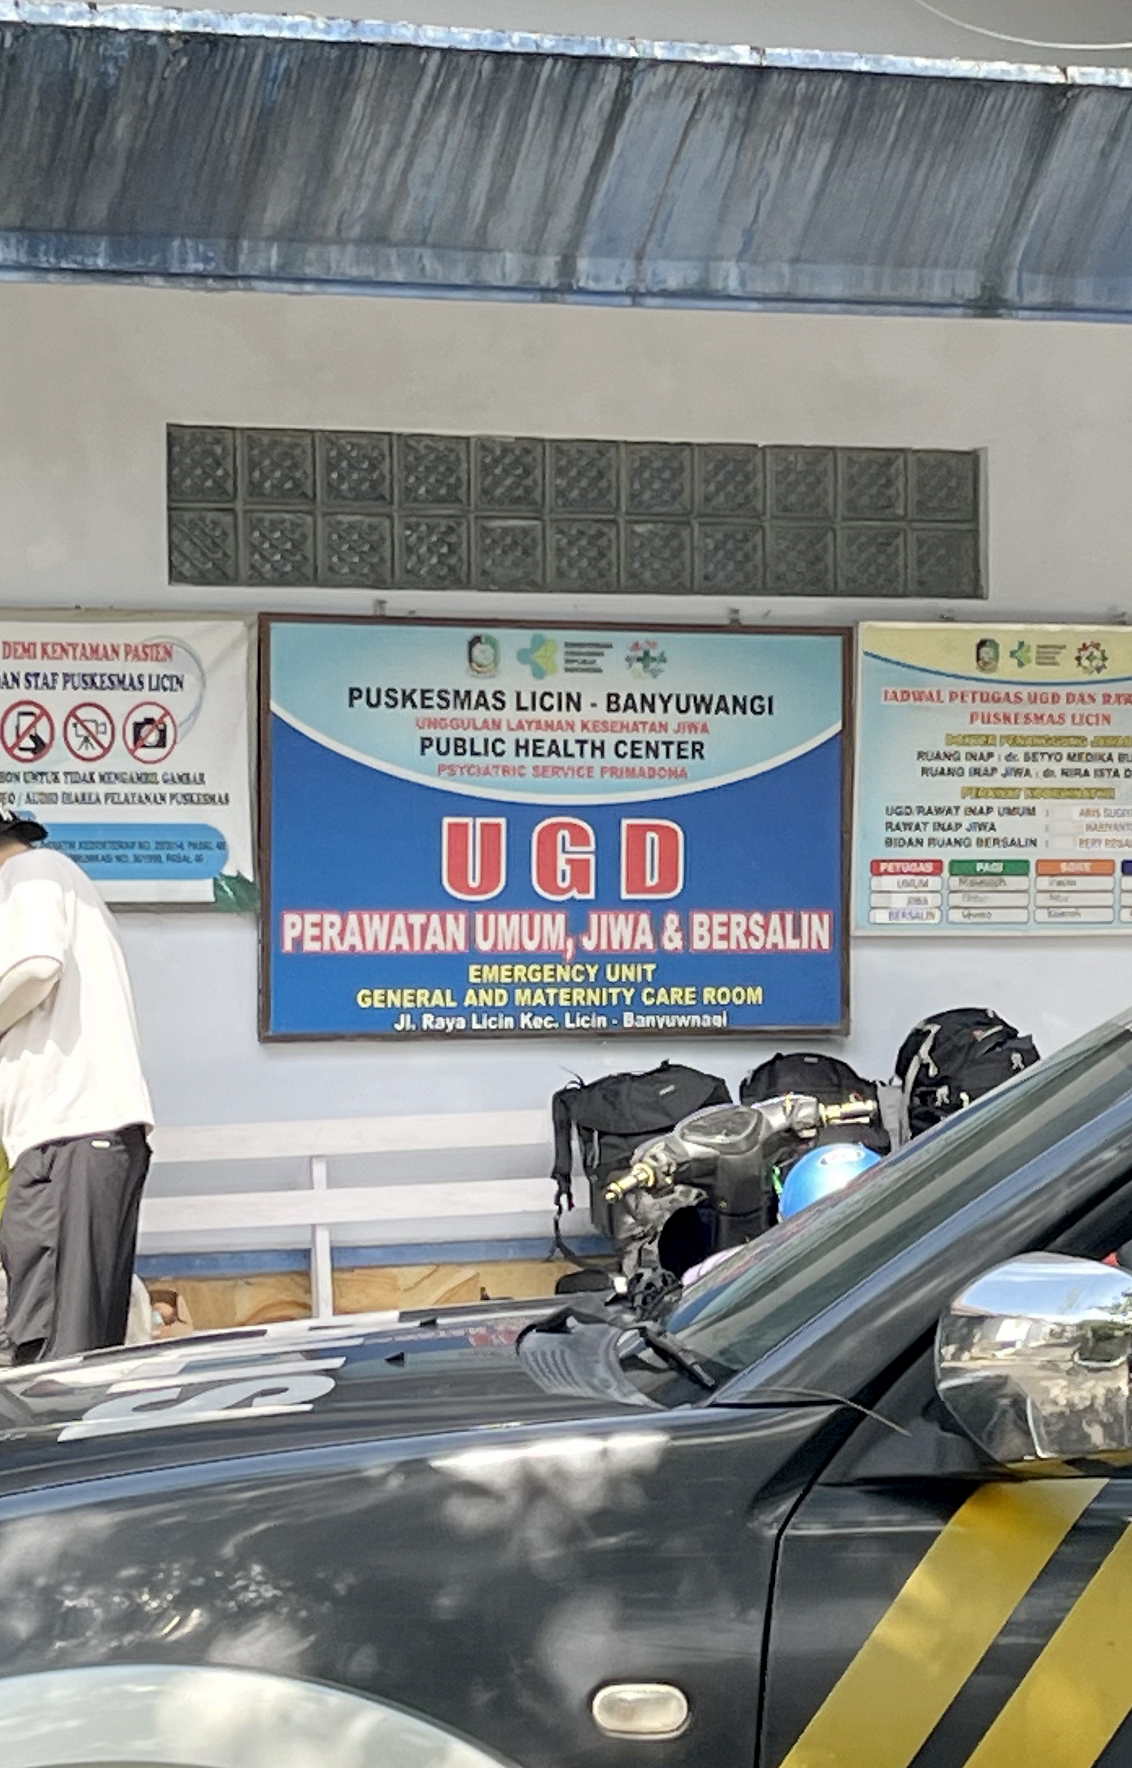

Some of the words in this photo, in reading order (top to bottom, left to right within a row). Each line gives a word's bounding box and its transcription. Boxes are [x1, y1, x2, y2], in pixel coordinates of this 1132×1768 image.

[2, 640, 37, 660] DEMI
[123, 642, 174, 663] PASIEN
[24, 672, 59, 691] STAF
[62, 672, 145, 692] PUSKESMAS
[148, 674, 185, 693] LICIN
[348, 687, 506, 711] PUSKESMAS
[515, 690, 582, 712] LICIN
[606, 692, 774, 715] BANYUWANGI
[883, 689, 944, 703] JADWAL
[949, 690, 1023, 704] PETUGAS
[1027, 691, 1061, 704] UGD
[1066, 692, 1096, 705] DAN
[415, 717, 502, 731] UNGGULAN
[506, 718, 575, 732] LAYANAN
[581, 719, 669, 733] KESEHATAN
[673, 720, 710, 734] JIWA
[969, 711, 1065, 725] PUSKESMAS
[1071, 712, 1111, 726] LICIN
[420, 736, 506, 757] PUBLIC
[514, 737, 605, 759] HEALTH
[614, 739, 705, 760] CENTER
[916, 750, 961, 761] RUANG
[965, 751, 995, 762] INAP
[62, 771, 96, 784] TIDAK
[161, 772, 206, 785] GAMBAR
[532, 764, 595, 778] SERVICE
[600, 766, 688, 779] PRIMADONA
[921, 766, 965, 777] RUANG
[169, 793, 230, 806] PUSKESMAS
[964, 806, 994, 816] INAP
[885, 822, 930, 832] RAWAT
[932, 822, 963, 832] INAP
[885, 837, 924, 848] BIDAN
[928, 837, 972, 848] RUANG
[975, 837, 1037, 848] BERSALIN
[281, 910, 468, 953] PERAWATAN
[474, 911, 574, 961] UMUM,
[582, 911, 656, 952] JIWA
[662, 911, 684, 952] &
[690, 910, 831, 953] BERSALIN
[468, 964, 599, 983] EMERGENCY
[606, 963, 657, 982] UNIT
[356, 988, 457, 1008] GENERAL
[464, 988, 508, 1008] AND
[514, 988, 636, 1007] MATERNITY
[641, 987, 697, 1006] CARE
[702, 986, 764, 1005] ROOM
[422, 1013, 466, 1032] Raya
[471, 1013, 514, 1030] Licin
[520, 1012, 560, 1030] Kec.
[565, 1012, 607, 1029] Licin
